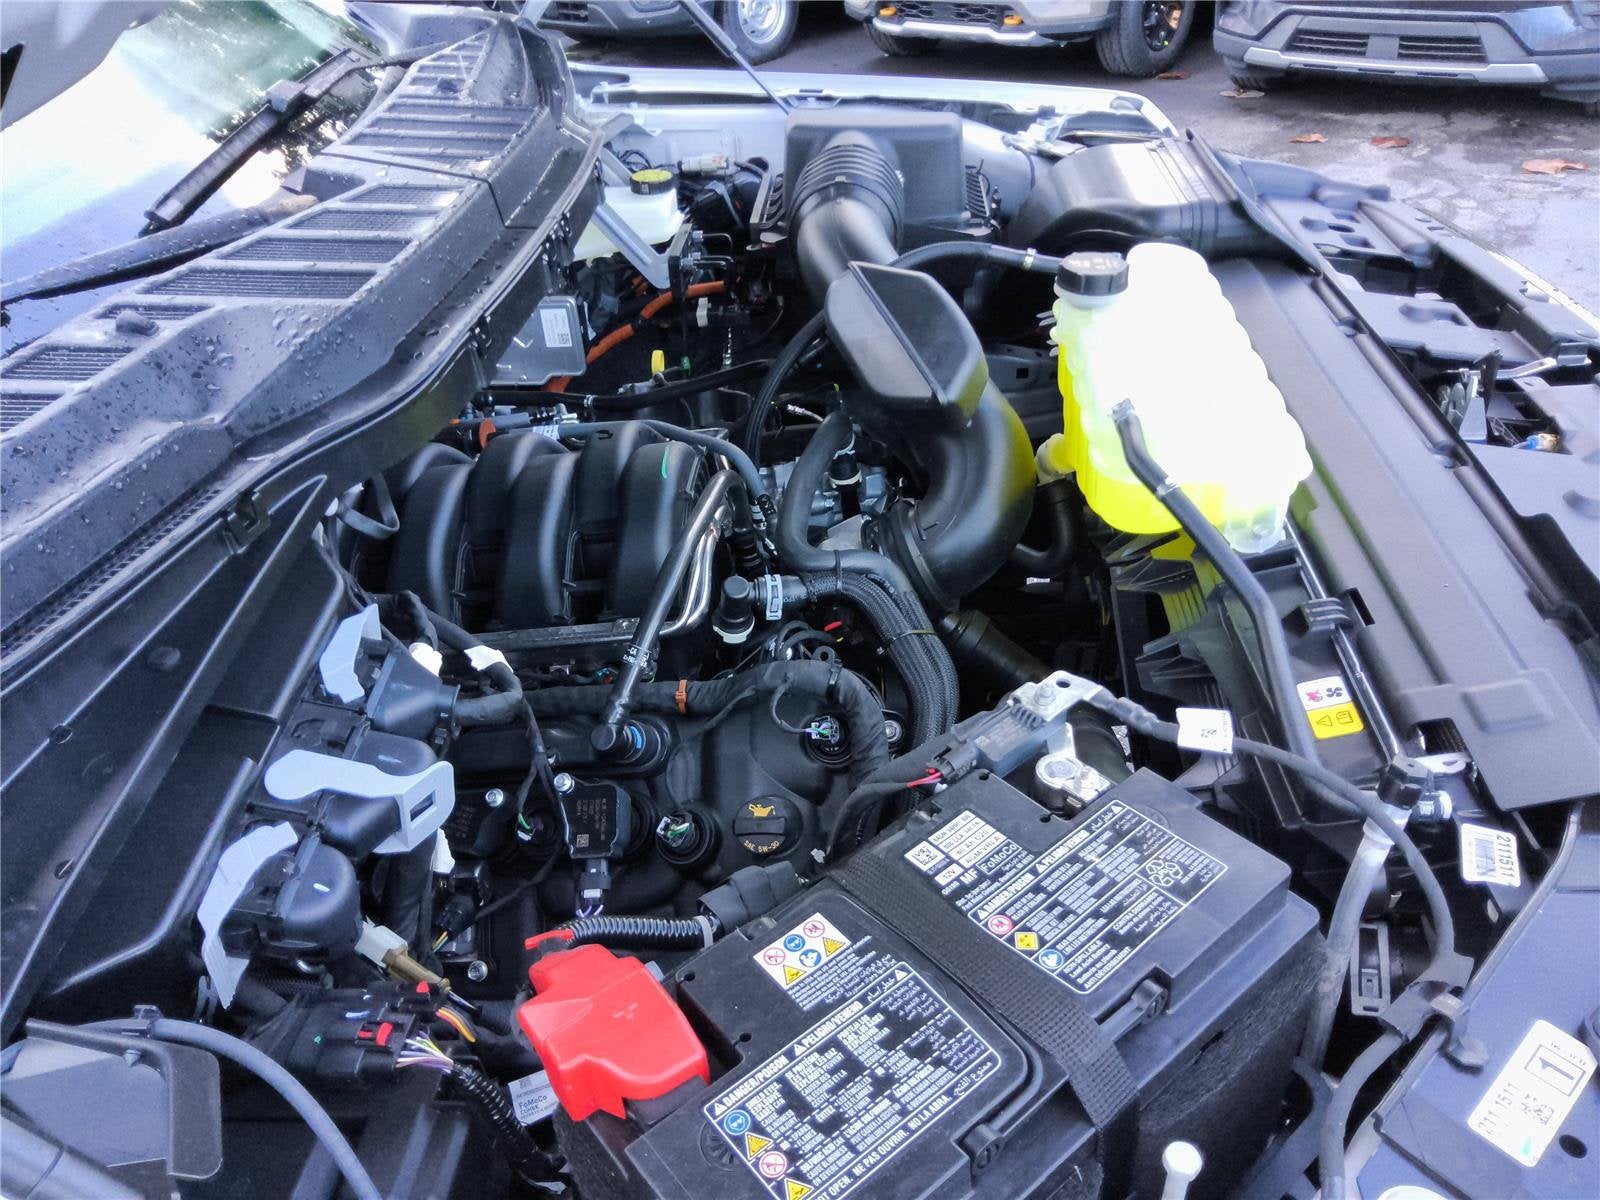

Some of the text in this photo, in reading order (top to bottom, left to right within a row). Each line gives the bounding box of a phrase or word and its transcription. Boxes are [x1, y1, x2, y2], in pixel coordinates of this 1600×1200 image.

[744, 840, 780, 852] SAE 5W-30
[978, 841, 1019, 871] FoMoCo
[941, 868, 957, 879] 12V
[958, 867, 982, 884] MF
[800, 999, 864, 1048] PELIGRO/VENENO
[720, 1054, 790, 1107] DANGER/POISON
[519, 1096, 547, 1109] FoMoCo
[826, 1092, 953, 1197] OPEN. NE PAS OUVRIR. NO LA ABRA.
